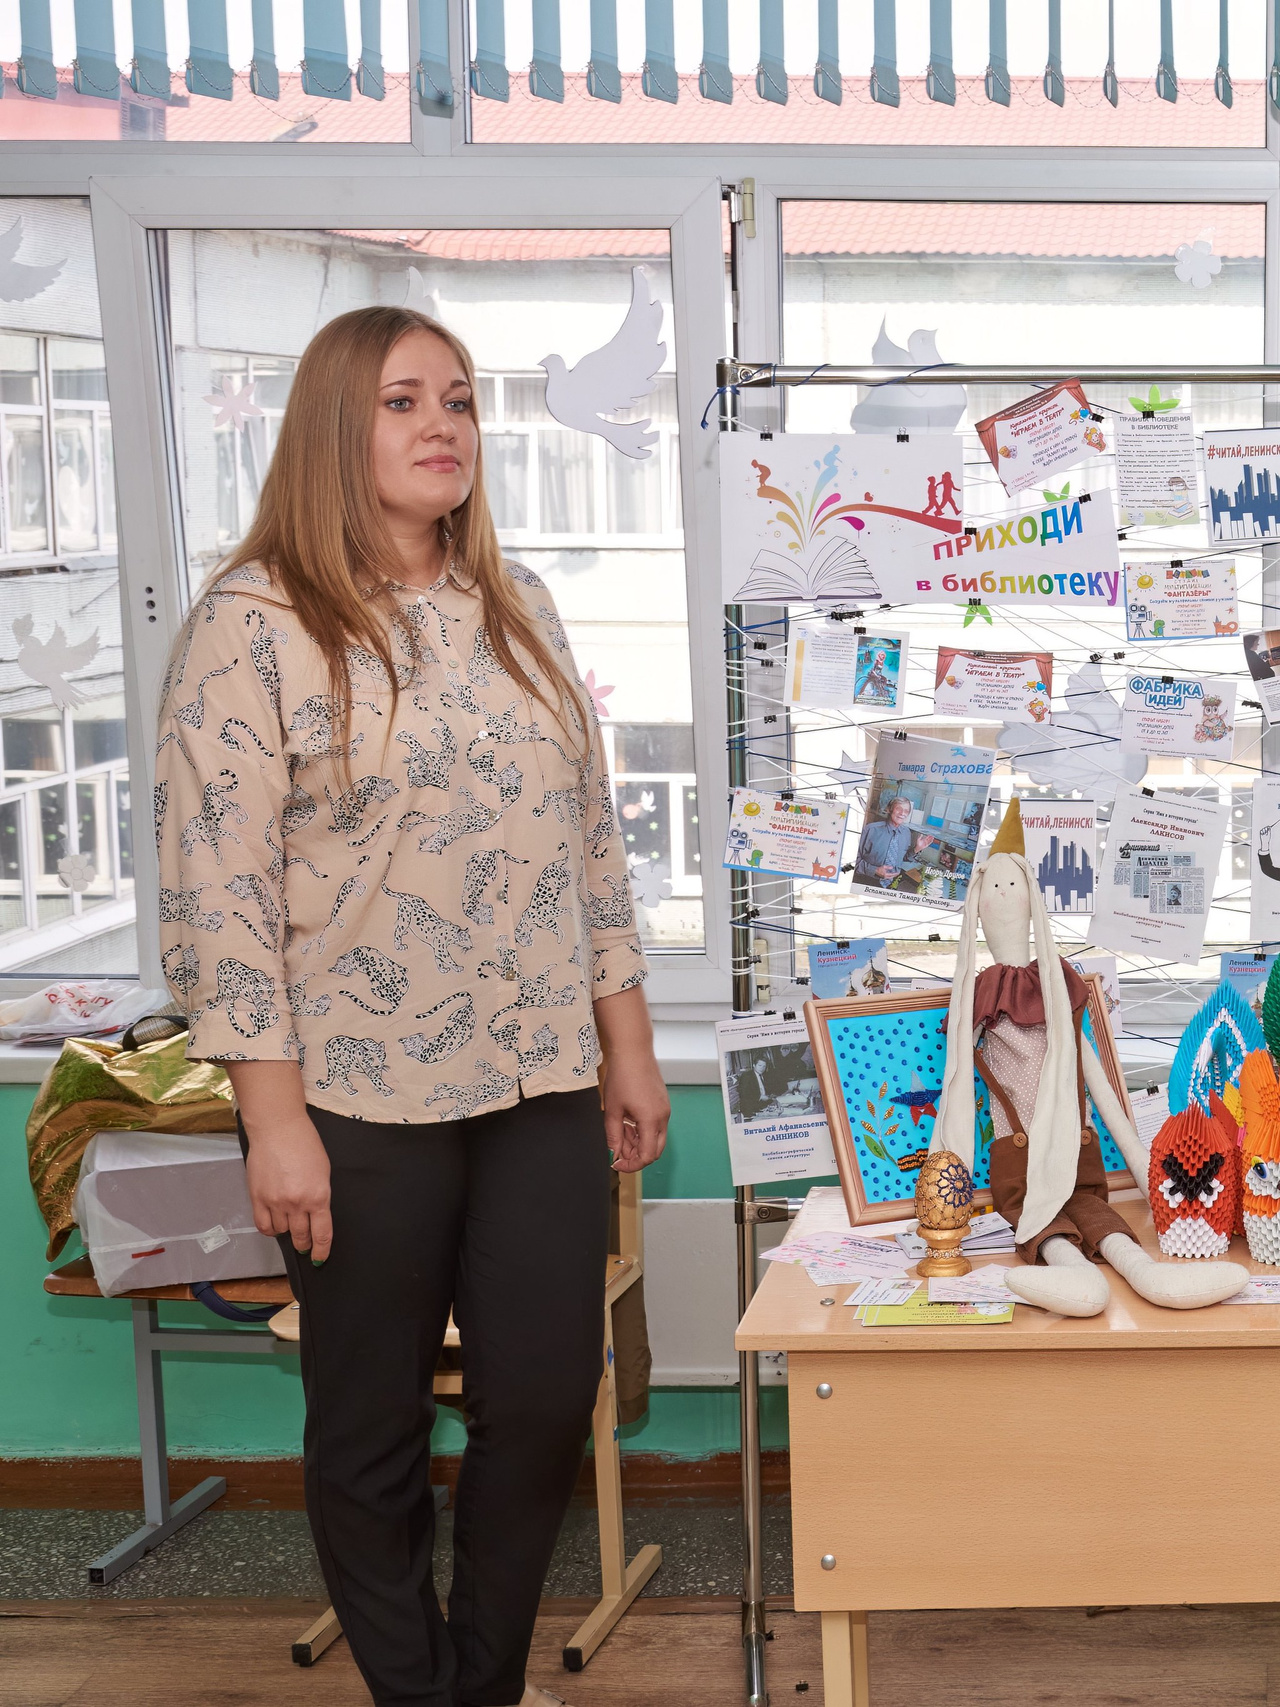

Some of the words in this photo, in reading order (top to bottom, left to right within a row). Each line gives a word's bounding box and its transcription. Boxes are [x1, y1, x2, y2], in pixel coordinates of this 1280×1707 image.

[1039, 418, 1043, 426] В
[933, 501, 1083, 560] ПРИХОДИ
[916, 580, 932, 591] в
[942, 571, 1119, 607] библиотеку
[1131, 677, 1201, 696] ФАБРИКА
[1148, 694, 1182, 707] ИДЕЙ
[898, 762, 925, 773] Тамара
[930, 762, 992, 776] Страхова
[769, 822, 817, 835] "ФАНТАЗЁРЫ"
[1131, 817, 1168, 830] Александр
[1170, 824, 1205, 838] Иванович
[1150, 829, 1185, 841] ЛАКИСОВ
[899, 891, 921, 902] Тамару
[817, 949, 850, 957] Ленинск-
[817, 954, 857, 964] Кузнецкий
[743, 1125, 776, 1135] Виталий
[765, 1131, 810, 1142] САННИКОВ
